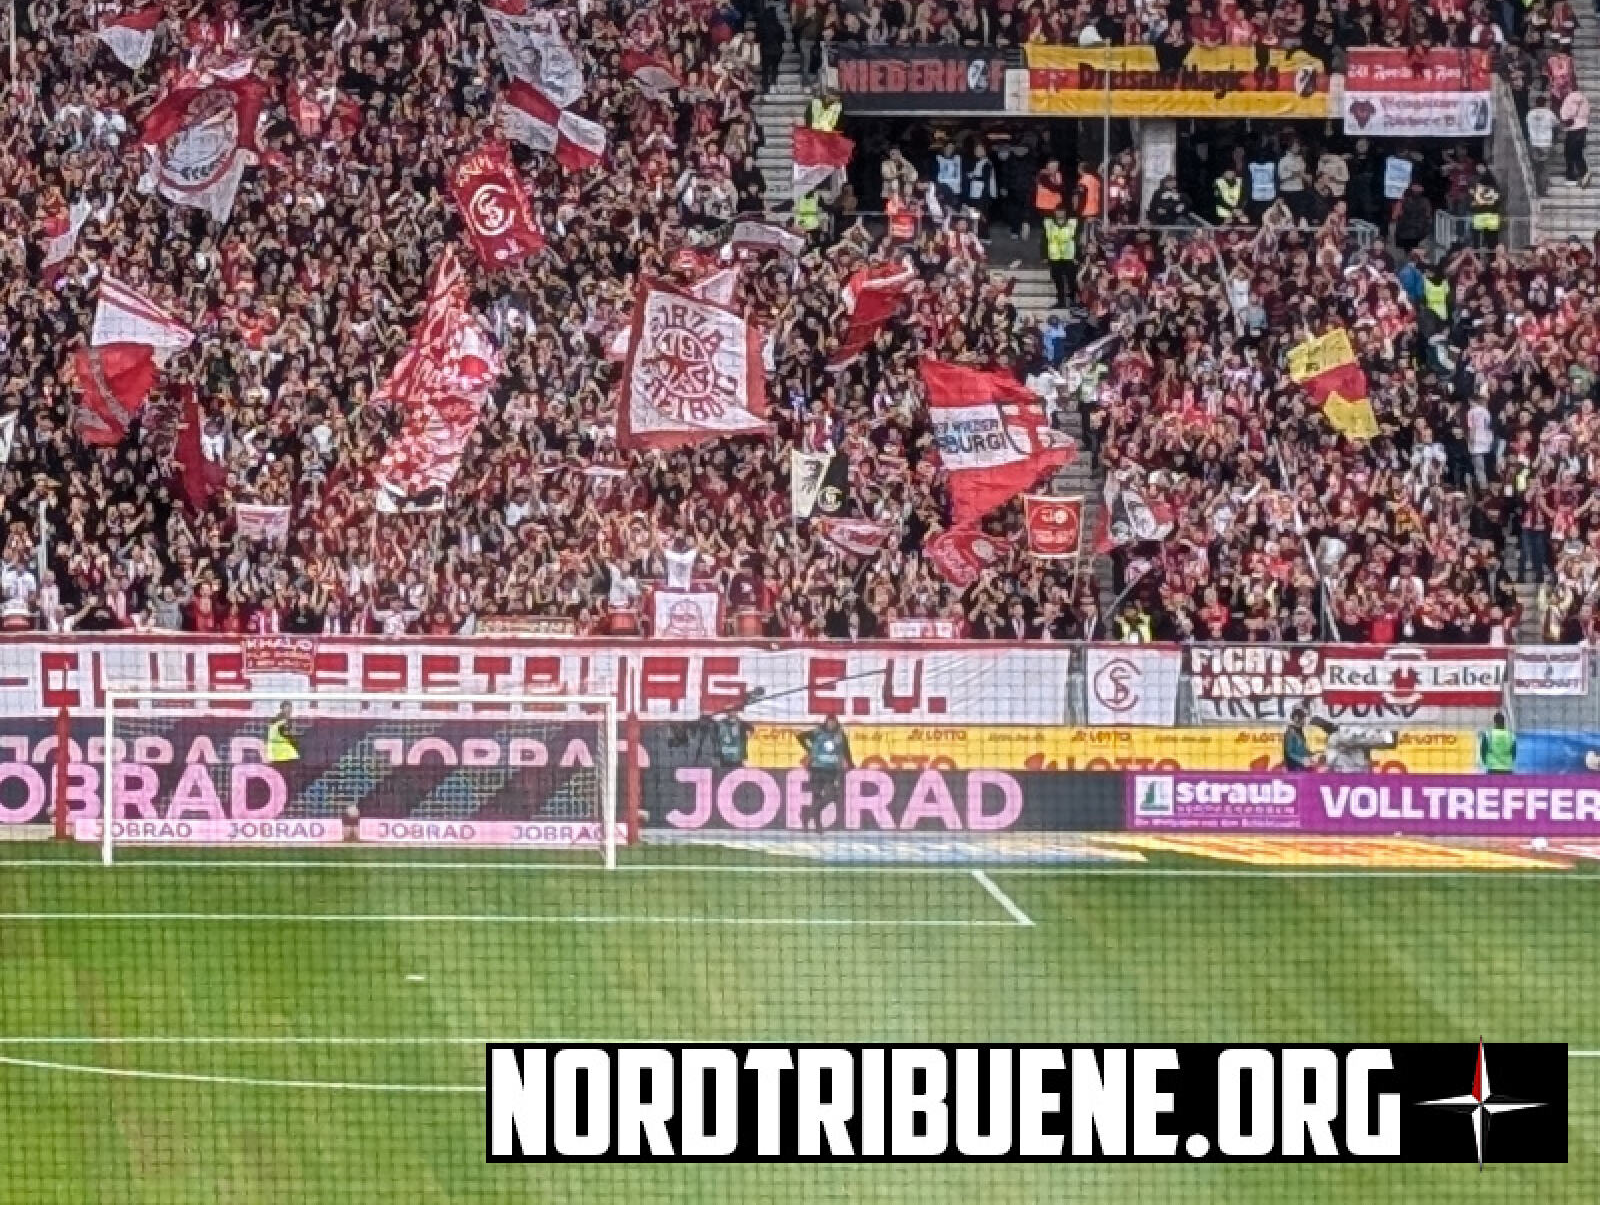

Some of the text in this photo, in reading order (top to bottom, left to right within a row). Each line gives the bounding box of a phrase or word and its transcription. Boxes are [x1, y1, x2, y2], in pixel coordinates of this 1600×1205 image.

[1328, 664, 1378, 685] Red
[1433, 664, 1506, 687] Label
[1175, 778, 1297, 804] straub
[1320, 785, 1600, 822] VOLLTREFFER
[227, 822, 327, 840] JOBRAD
[377, 822, 477, 841] JOBRAD
